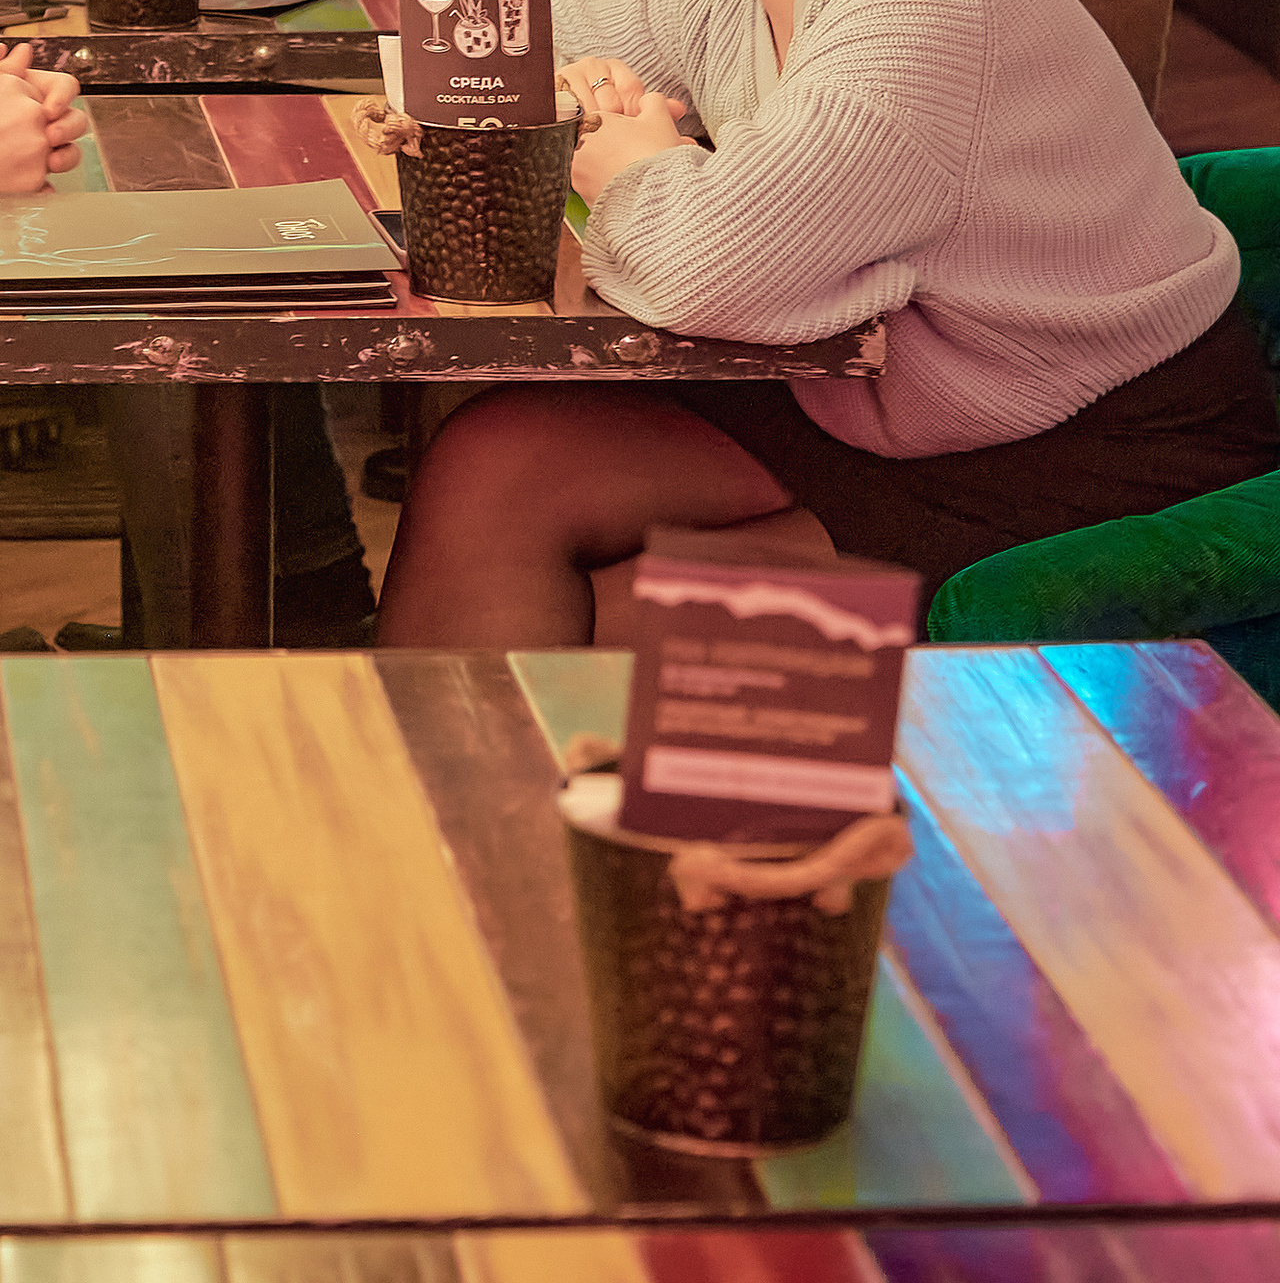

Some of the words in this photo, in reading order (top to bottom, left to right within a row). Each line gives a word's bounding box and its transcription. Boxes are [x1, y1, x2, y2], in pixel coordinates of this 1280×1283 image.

[449, 76, 505, 91] СРЕДА
[436, 94, 496, 104] COCKTAILS
[497, 94, 521, 104] DAY
